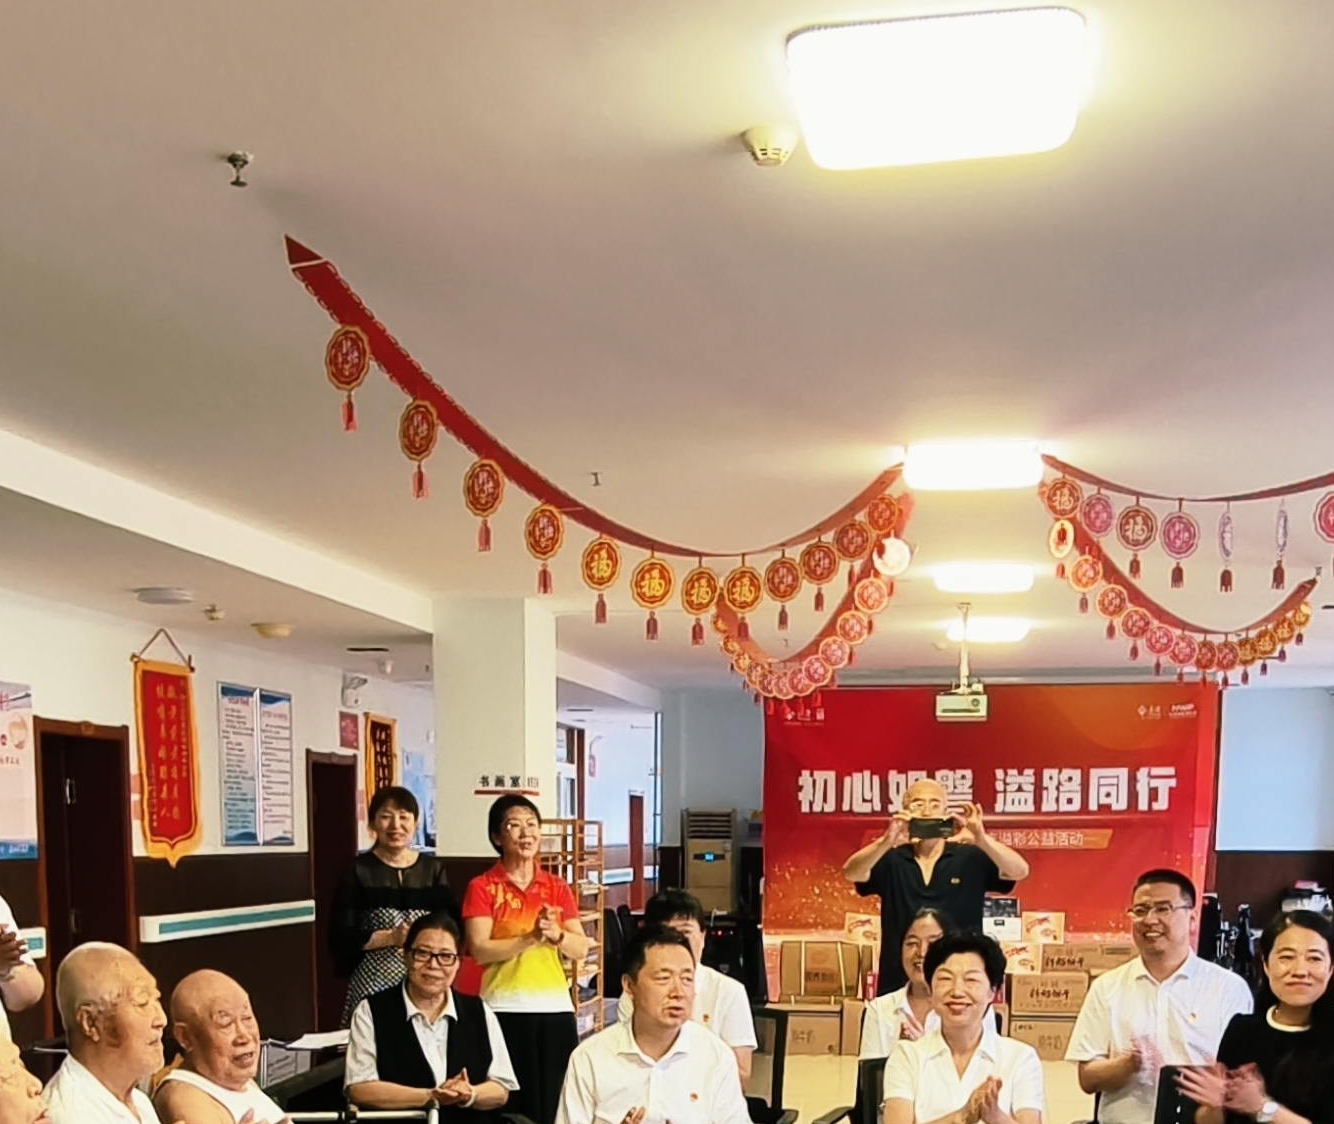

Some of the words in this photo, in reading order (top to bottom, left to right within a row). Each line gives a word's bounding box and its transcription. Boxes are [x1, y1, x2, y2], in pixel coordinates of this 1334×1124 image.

[1124, 515, 1149, 542] 福
[589, 547, 613, 581] 福
[638, 567, 666, 599] 福
[688, 577, 712, 605] 福
[730, 574, 756, 605] 福
[993, 766, 1178, 813] 溢路同行
